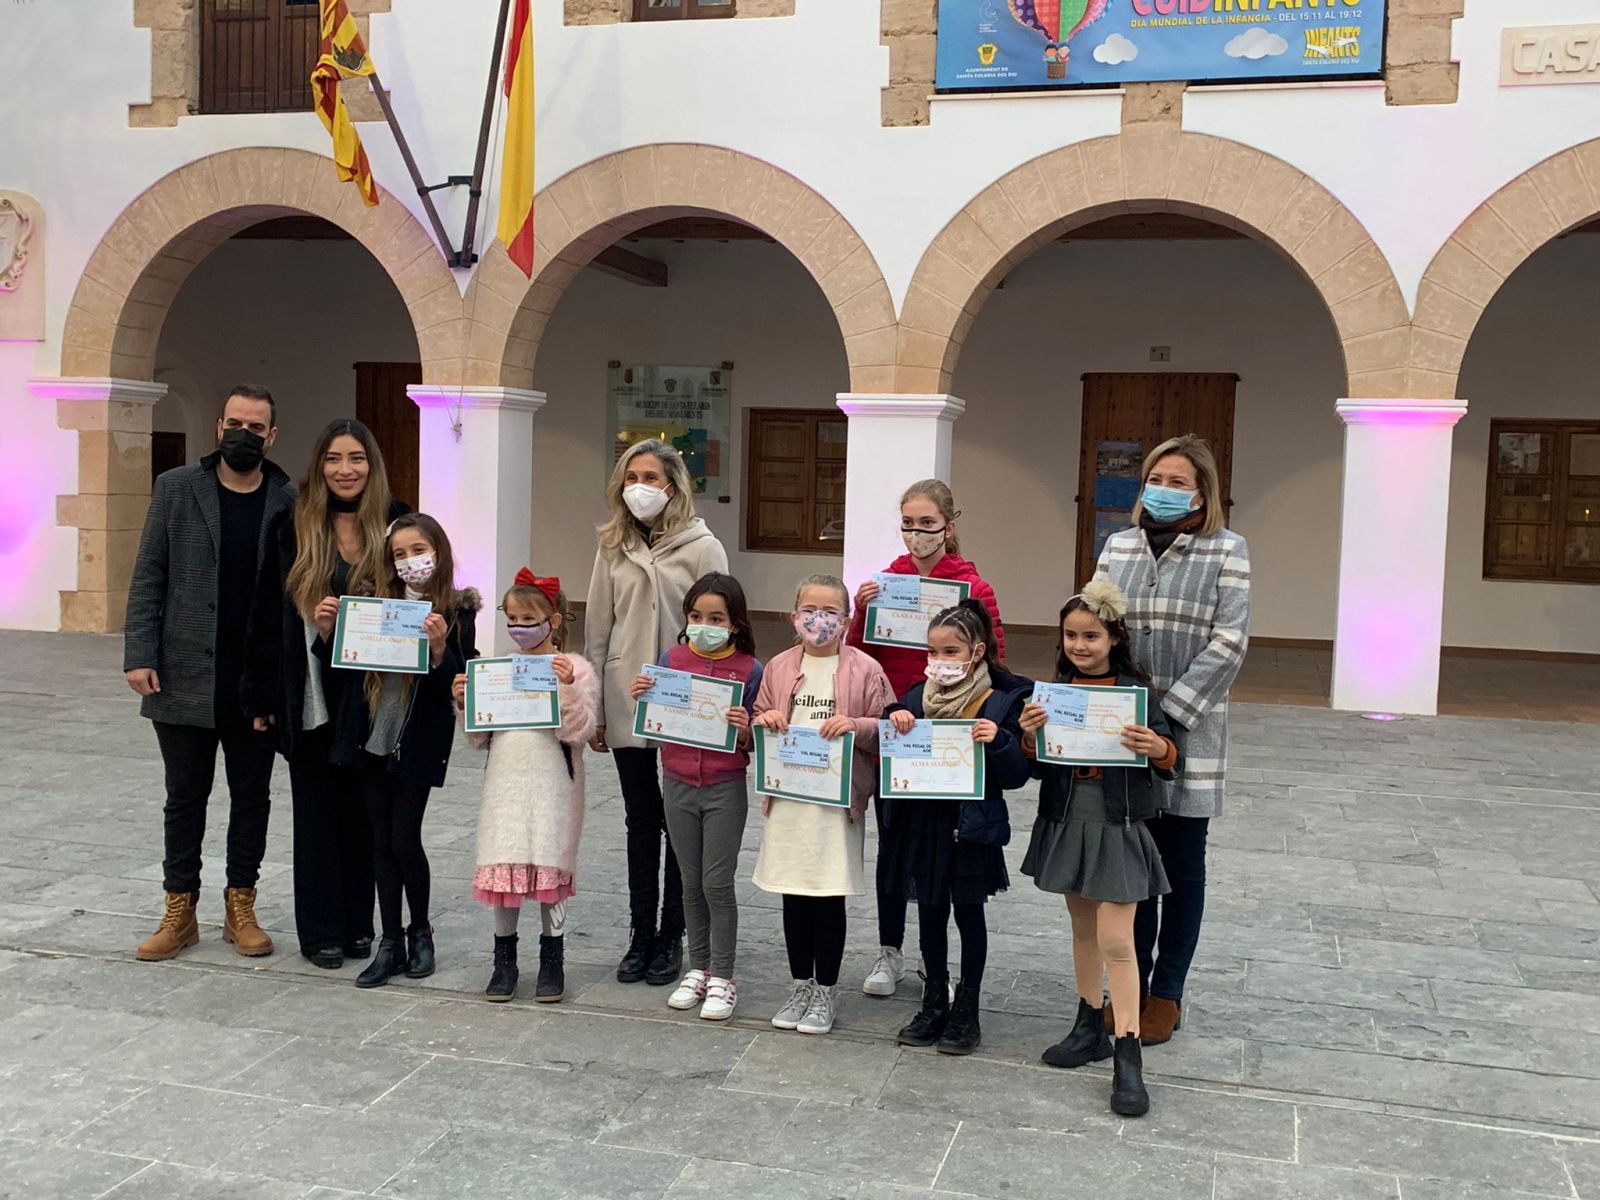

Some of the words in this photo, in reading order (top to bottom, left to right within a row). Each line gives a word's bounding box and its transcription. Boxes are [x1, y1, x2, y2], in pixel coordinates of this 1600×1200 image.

[1149, 17, 1192, 27] MUNDIAL
[1195, 16, 1209, 25] DE
[1211, 15, 1222, 25] LA
[1278, 13, 1296, 22] DEL
[1324, 11, 1337, 20] AL
[792, 693, 836, 708] eilleur
[810, 708, 835, 720] ami
